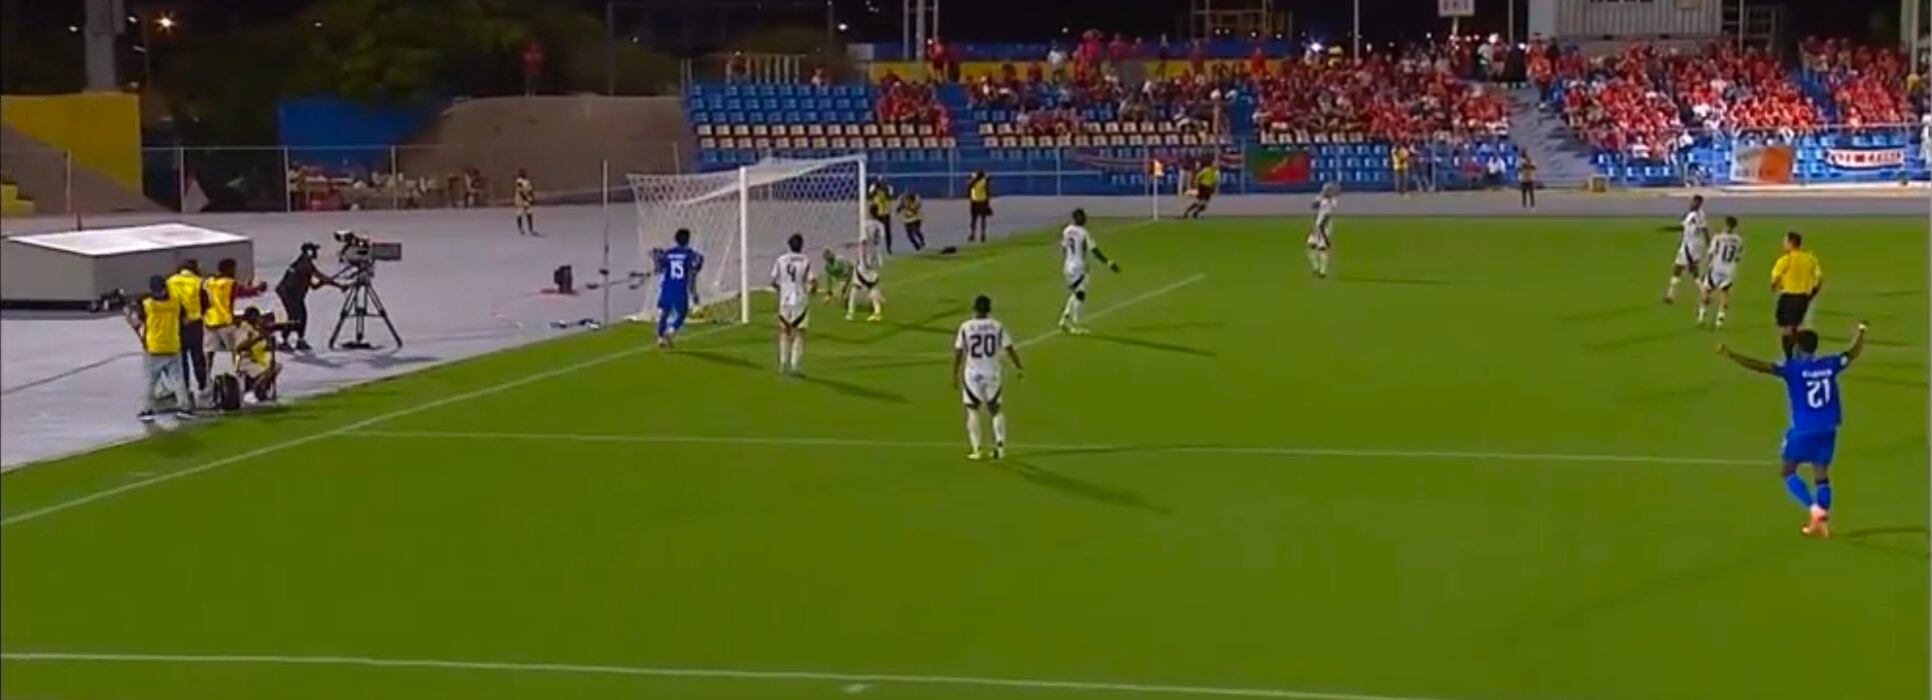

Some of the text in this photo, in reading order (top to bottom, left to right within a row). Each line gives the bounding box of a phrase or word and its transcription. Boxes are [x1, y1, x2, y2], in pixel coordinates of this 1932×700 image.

[670, 259, 684, 279] 15
[786, 263, 797, 282] 4
[969, 333, 996, 359] 20
[1806, 378, 1831, 409] 21
